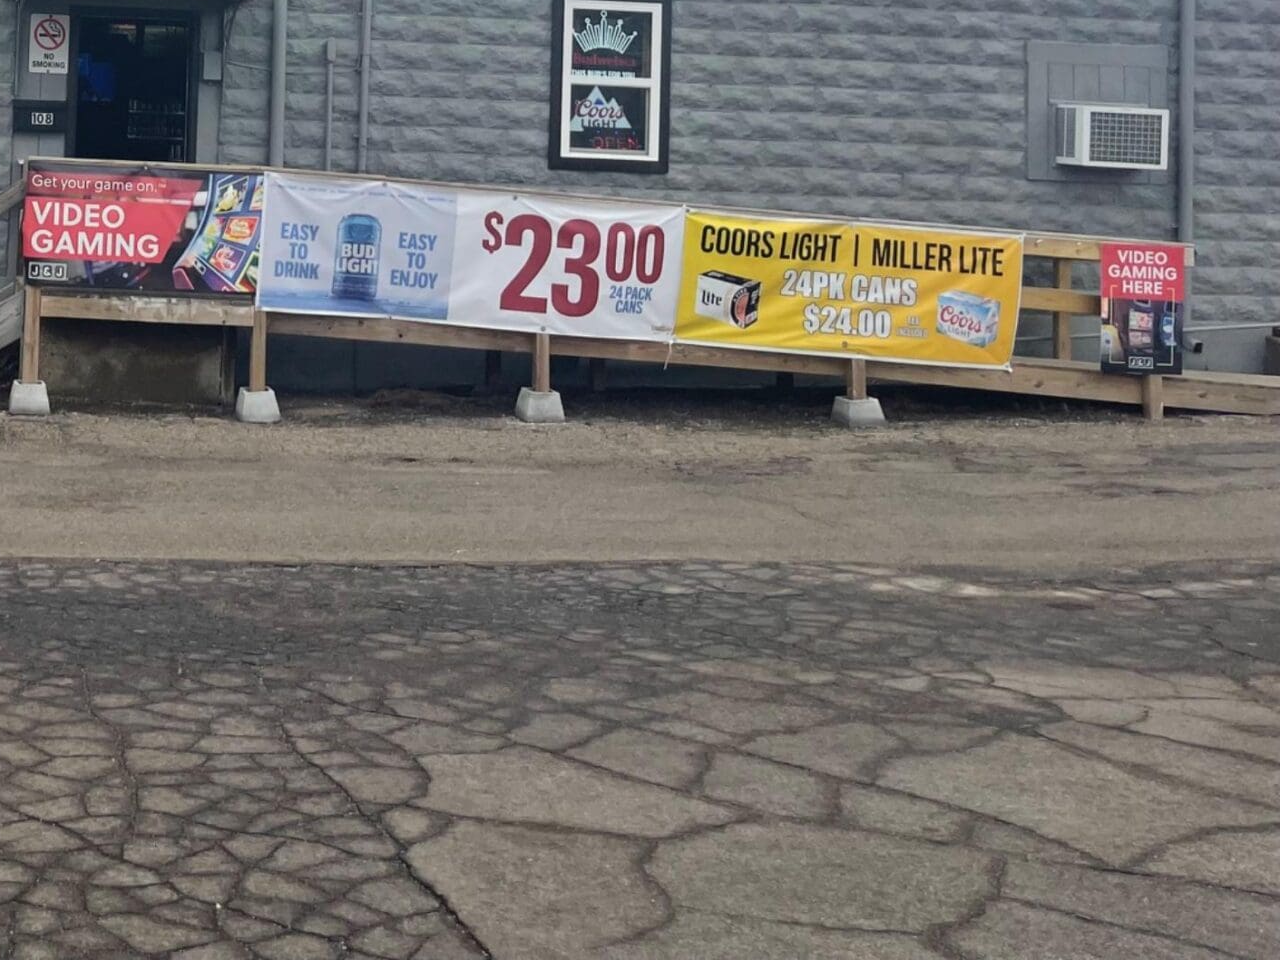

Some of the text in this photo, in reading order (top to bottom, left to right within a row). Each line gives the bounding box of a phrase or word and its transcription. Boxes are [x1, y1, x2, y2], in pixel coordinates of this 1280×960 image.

[32, 60, 66, 69] SMOKING
[575, 98, 624, 119] Coors
[32, 113, 54, 125] 108
[581, 118, 617, 128] LIGHT
[31, 174, 58, 188] Get
[61, 178, 92, 195] your
[94, 180, 133, 194] game
[31, 201, 125, 229] VIDEO
[281, 222, 320, 241] EASY
[30, 229, 160, 259] GAMING
[289, 242, 308, 260] TO
[341, 243, 376, 259] BUD
[398, 232, 438, 252] EASY
[700, 224, 775, 259] COORS
[779, 231, 842, 263] LIGHT
[871, 238, 953, 273] MILLER
[958, 246, 1005, 277] LITE
[336, 257, 378, 274] LIGHT
[407, 252, 426, 270] TO
[1117, 250, 1168, 265] VIDEO
[274, 261, 320, 281] DRINK
[390, 269, 439, 289] ENJOY
[1108, 265, 1178, 280] GAMING
[609, 285, 653, 301] 24 PACK
[780, 269, 846, 300] 24PK
[851, 274, 918, 307] CANS
[1122, 280, 1164, 295] HERE
[701, 289, 723, 306] Lite
[615, 300, 643, 314] CANS
[803, 303, 892, 338] $24.00
[940, 305, 982, 333] Coors
